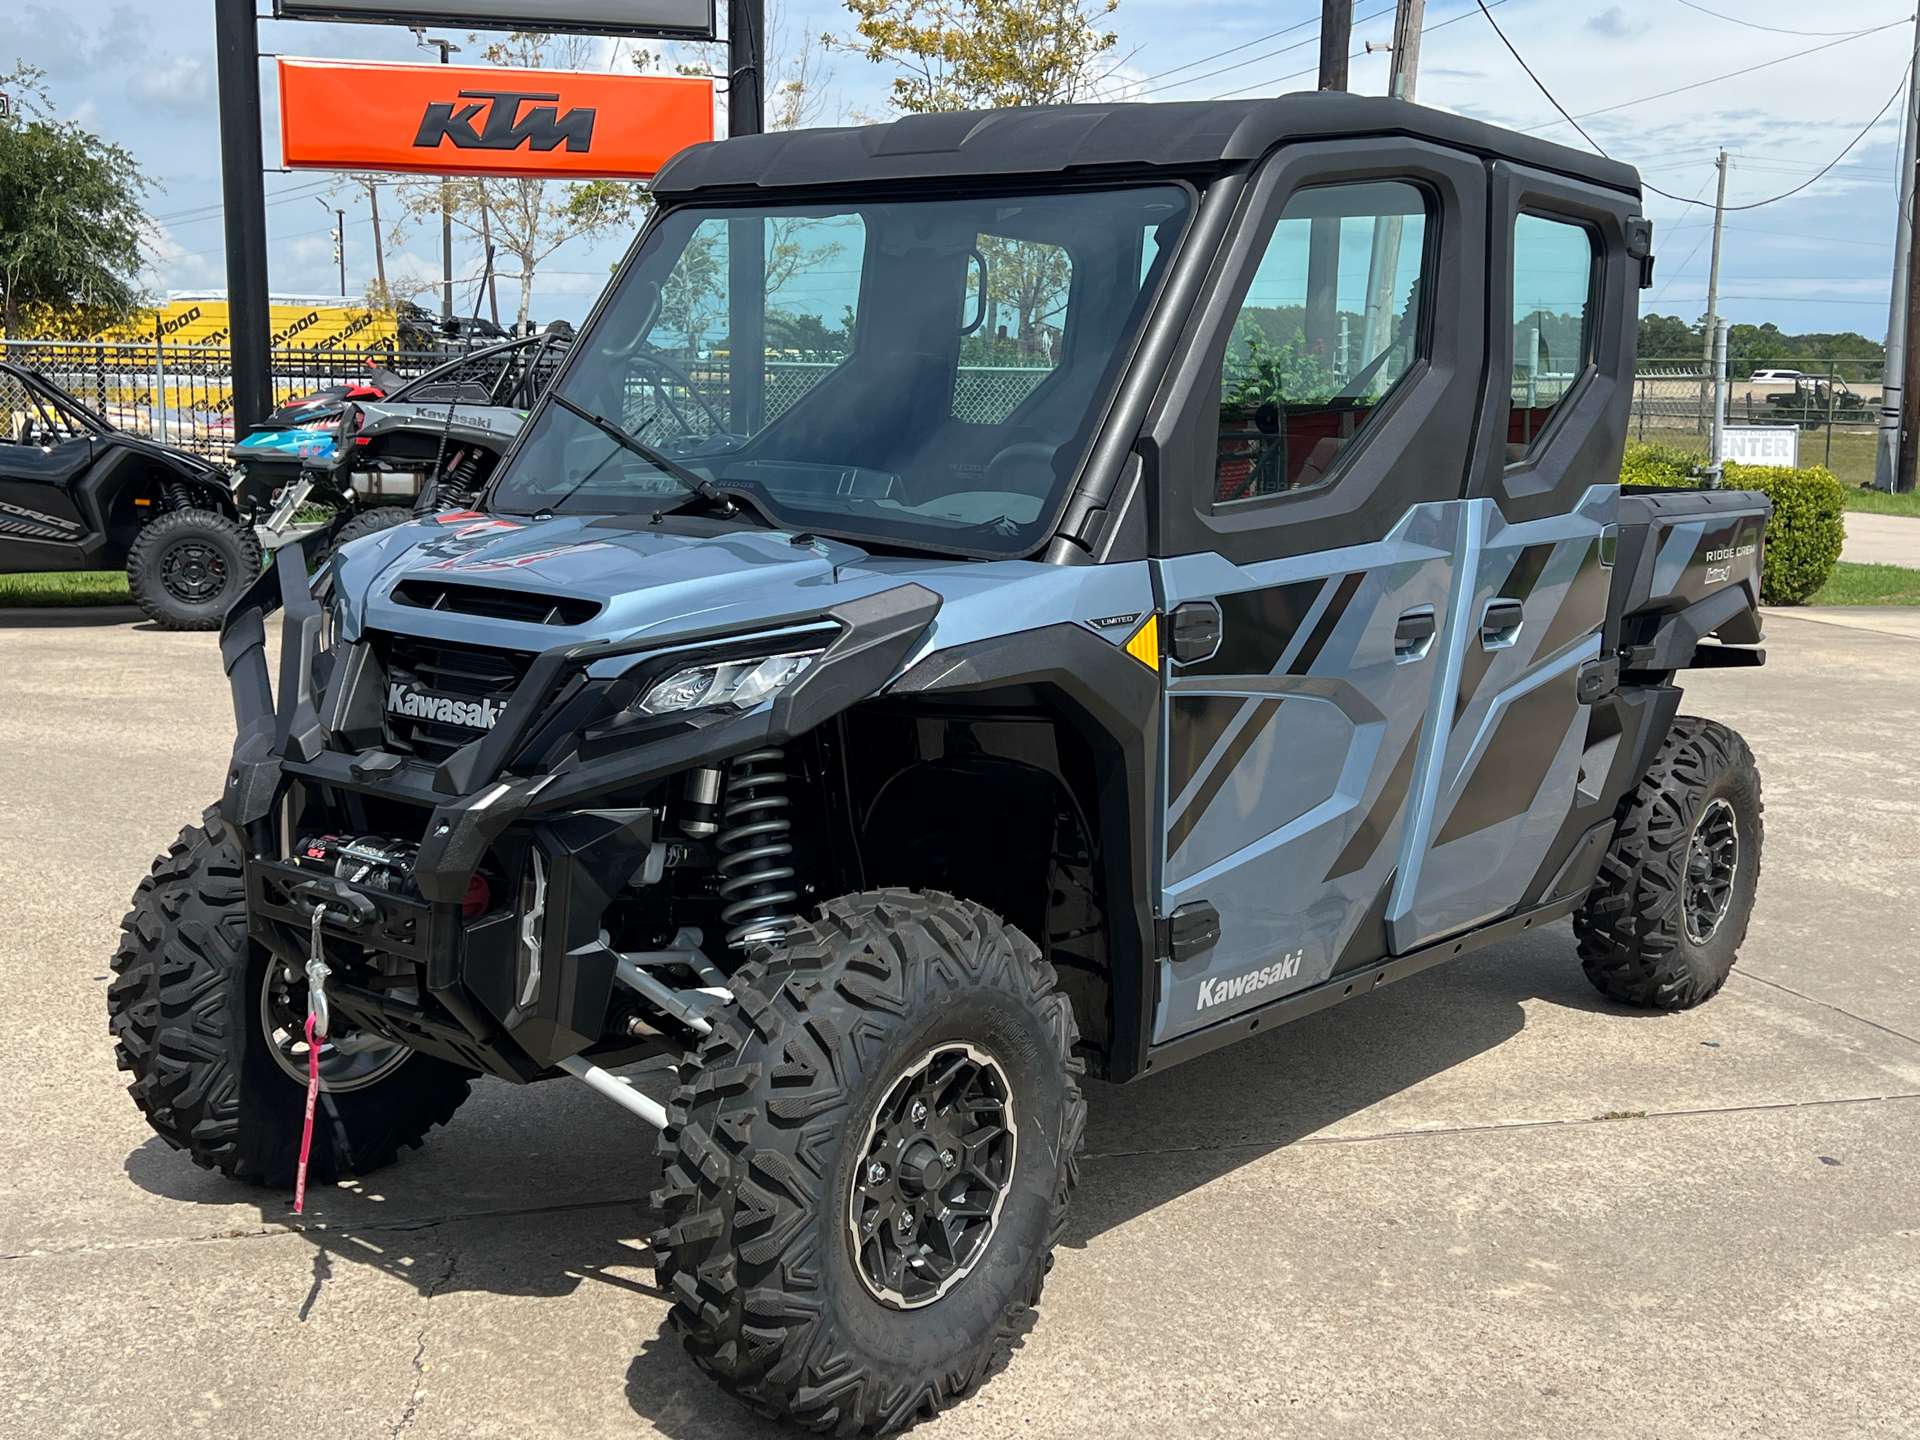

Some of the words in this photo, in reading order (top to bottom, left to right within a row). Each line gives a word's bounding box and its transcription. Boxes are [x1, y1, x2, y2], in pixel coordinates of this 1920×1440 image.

[413, 90, 596, 152] KTM
[415, 407, 492, 429] Kawasaki
[719, 480, 757, 489] RIDGE
[0, 502, 81, 531] ORCE
[1706, 548, 1735, 562] RIDGE
[1736, 544, 1756, 557] CREW
[1101, 615, 1133, 626] LIMITED
[1196, 949, 1303, 1011] Kawasaki
